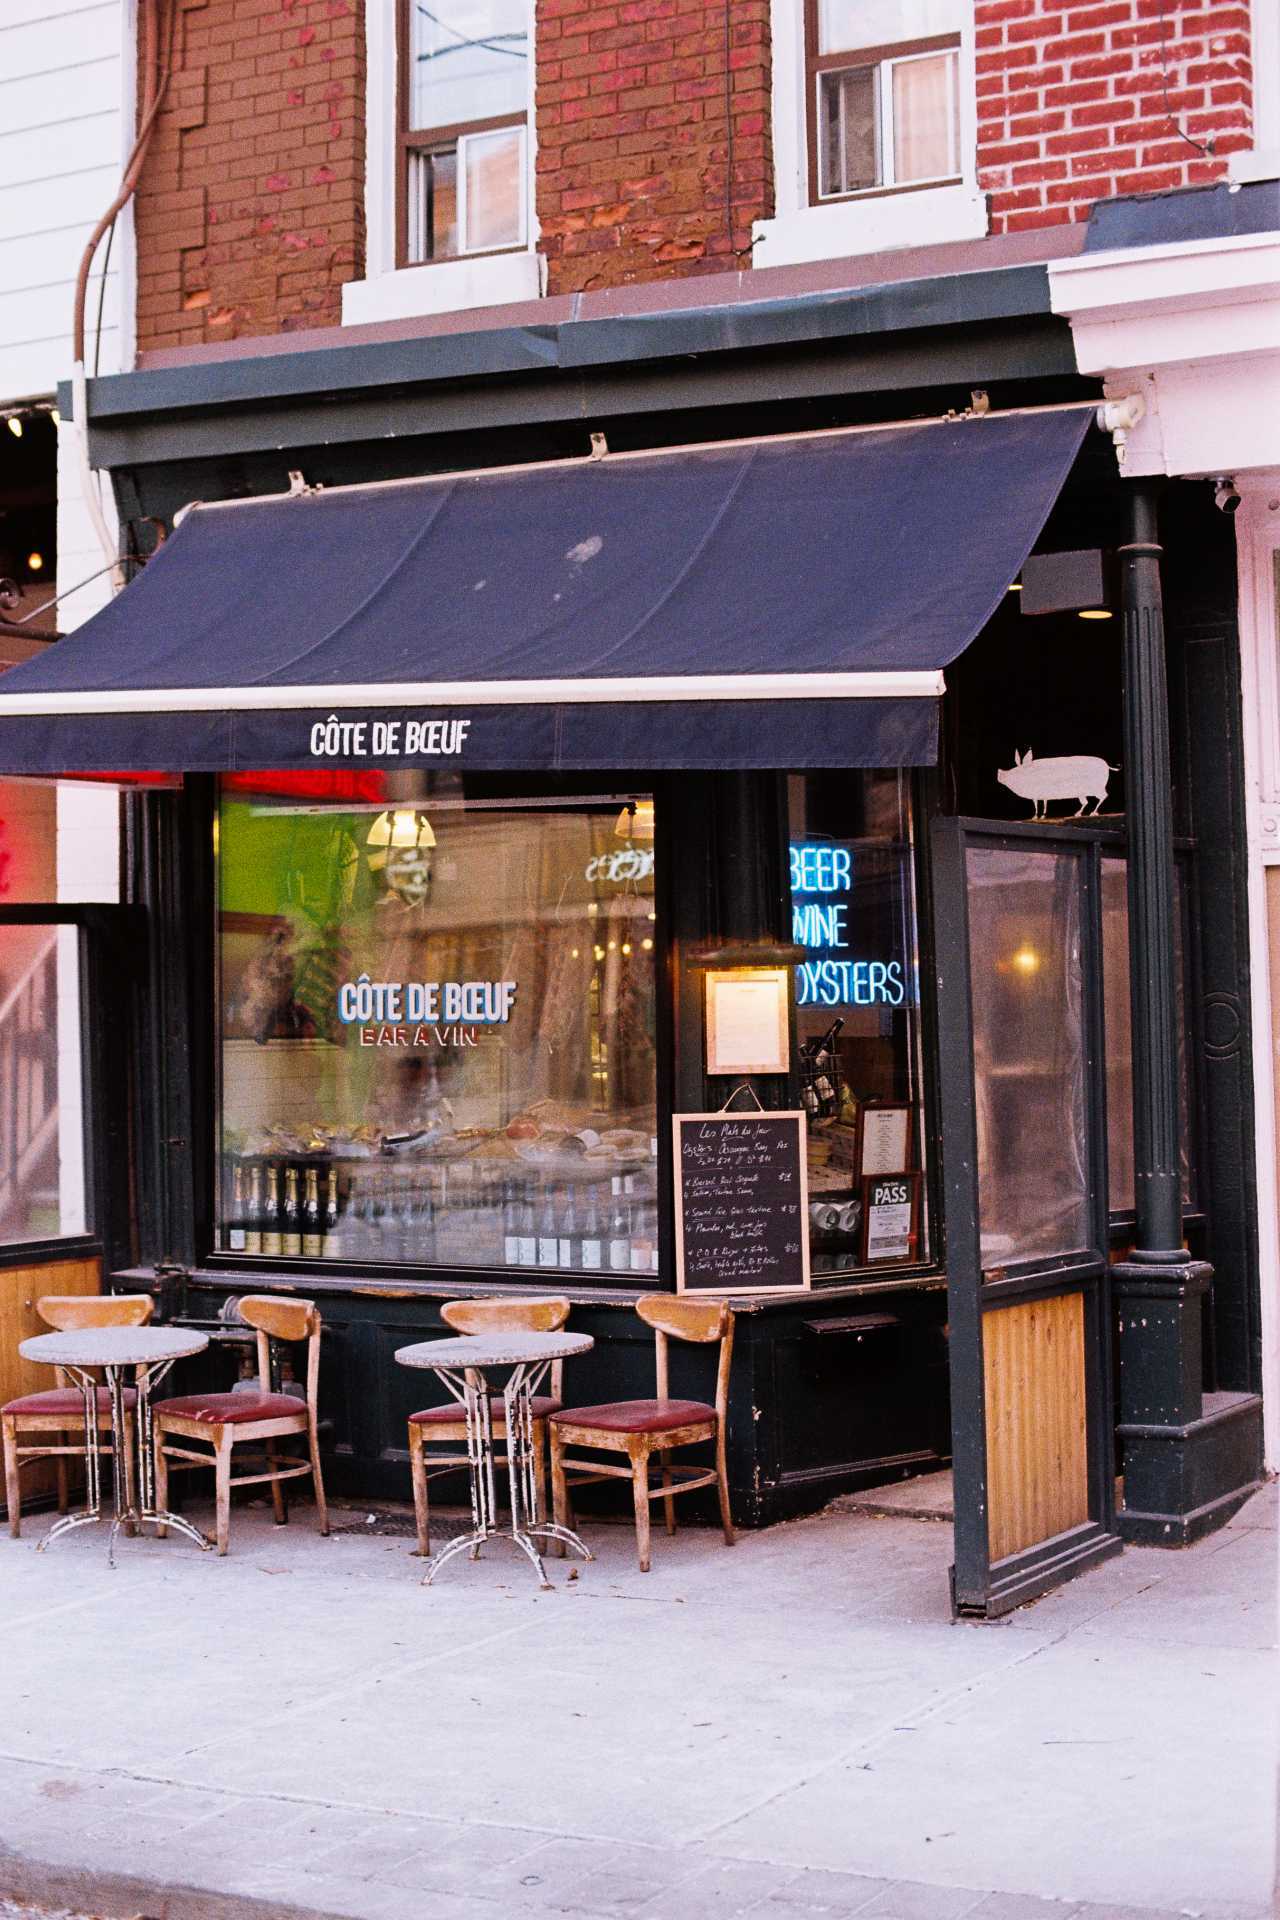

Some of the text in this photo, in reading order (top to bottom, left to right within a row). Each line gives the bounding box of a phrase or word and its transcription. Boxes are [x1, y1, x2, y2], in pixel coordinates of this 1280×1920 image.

[310, 713, 472, 756] CÔTE DE BŒUF
[789, 847, 851, 892] BEER
[338, 973, 517, 1024] CÔTE DE BŒUF
[360, 1023, 478, 1047] BAR À VIN
[875, 1186, 907, 1205] PASS
